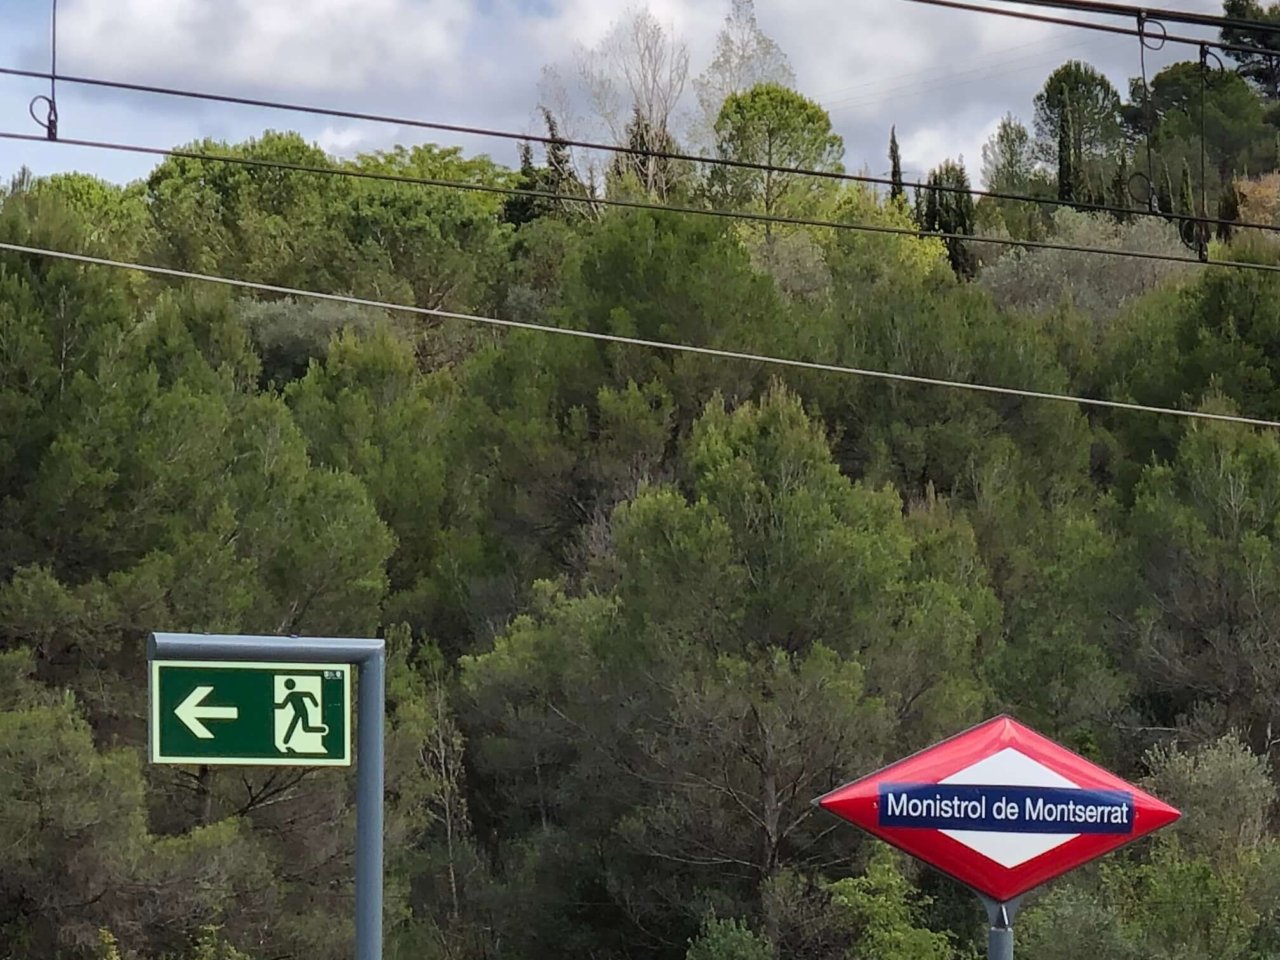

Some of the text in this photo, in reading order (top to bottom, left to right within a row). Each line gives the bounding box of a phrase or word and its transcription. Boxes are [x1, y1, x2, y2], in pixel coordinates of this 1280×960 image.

[887, 792, 1129, 824] Monistrol de Montserrat
